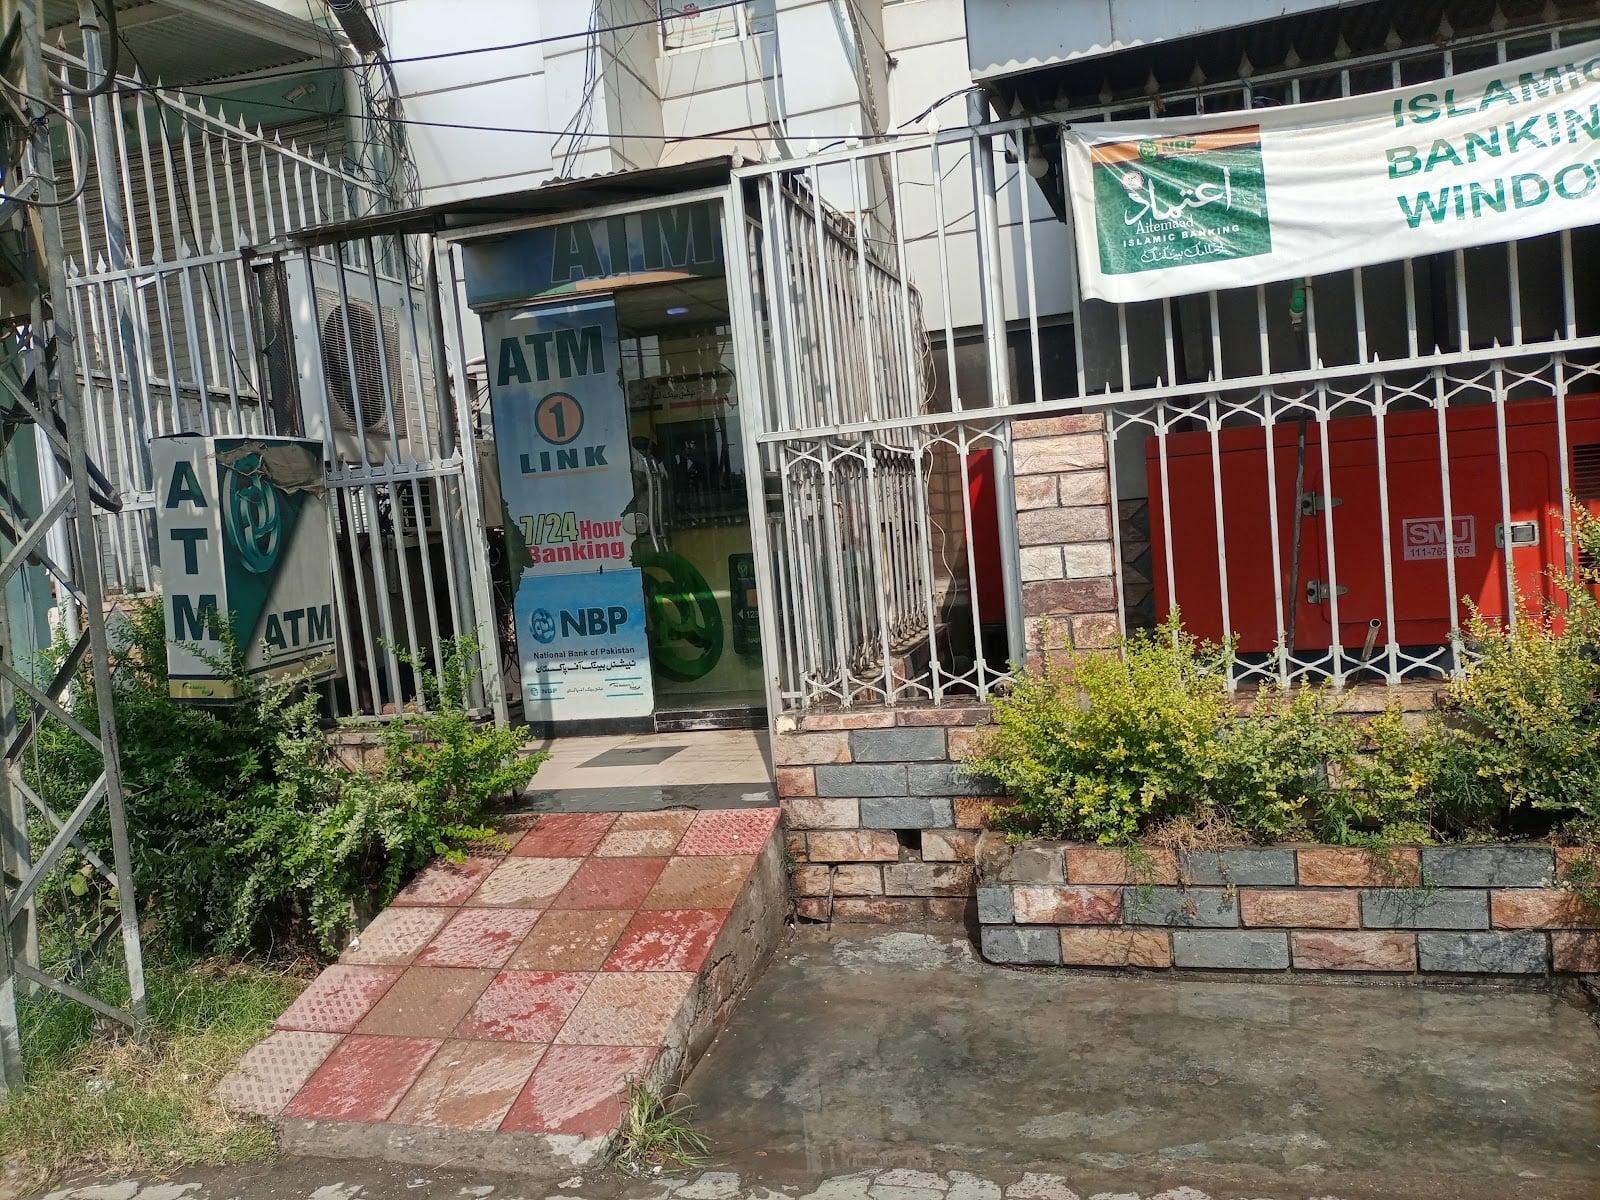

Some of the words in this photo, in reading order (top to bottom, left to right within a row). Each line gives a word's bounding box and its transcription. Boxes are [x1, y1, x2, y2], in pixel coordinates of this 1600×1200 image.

[1124, 166, 1232, 226] اعتماد
[1397, 158, 1600, 229] WINDO
[1123, 232, 1176, 248] ISLAMIC
[1181, 224, 1240, 239] BANKING
[1136, 214, 1194, 235] Aitemaad
[550, 203, 715, 283] ATM
[497, 324, 605, 386] ATM
[549, 402, 565, 438] 1
[519, 444, 608, 474] LINK
[520, 511, 579, 546] 7/24
[579, 519, 622, 540] Hour
[1410, 521, 1468, 544] SMJ
[166, 461, 219, 641] ATM
[527, 540, 625, 564] Banking
[263, 604, 333, 653] ATM
[559, 605, 628, 638] NBP
[533, 651, 566, 660] National
[568, 649, 588, 658] Bank
[590, 648, 599, 656] of
[601, 646, 635, 655] Pakistan
